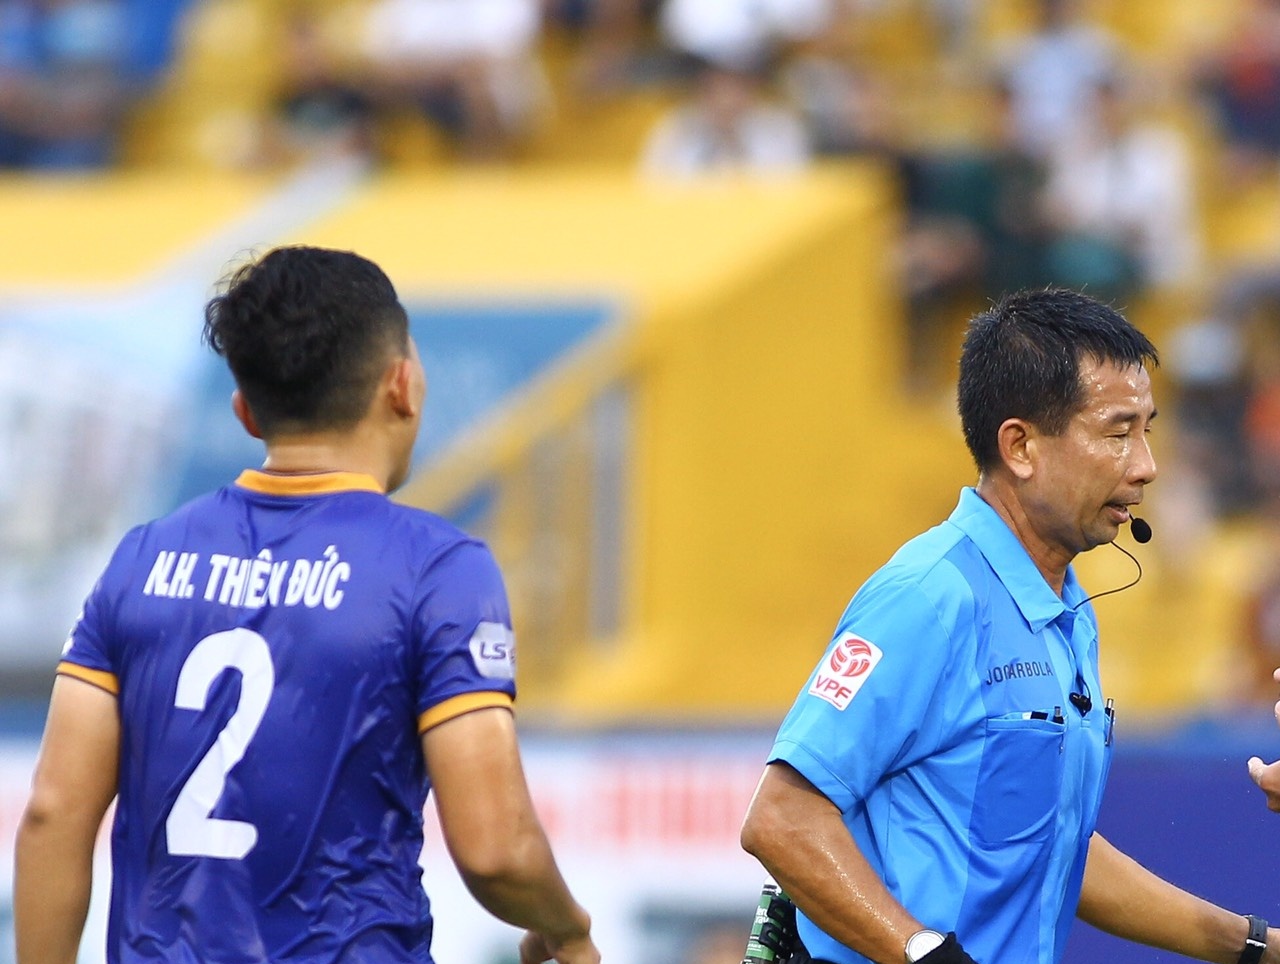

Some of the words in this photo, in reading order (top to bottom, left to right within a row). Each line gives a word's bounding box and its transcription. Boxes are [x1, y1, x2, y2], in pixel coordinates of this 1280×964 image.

[143, 550, 199, 599] N.H.
[284, 544, 350, 611] ĐỨC
[480, 640, 507, 660] LS
[815, 674, 853, 700] VPF
[164, 626, 276, 860] 2
